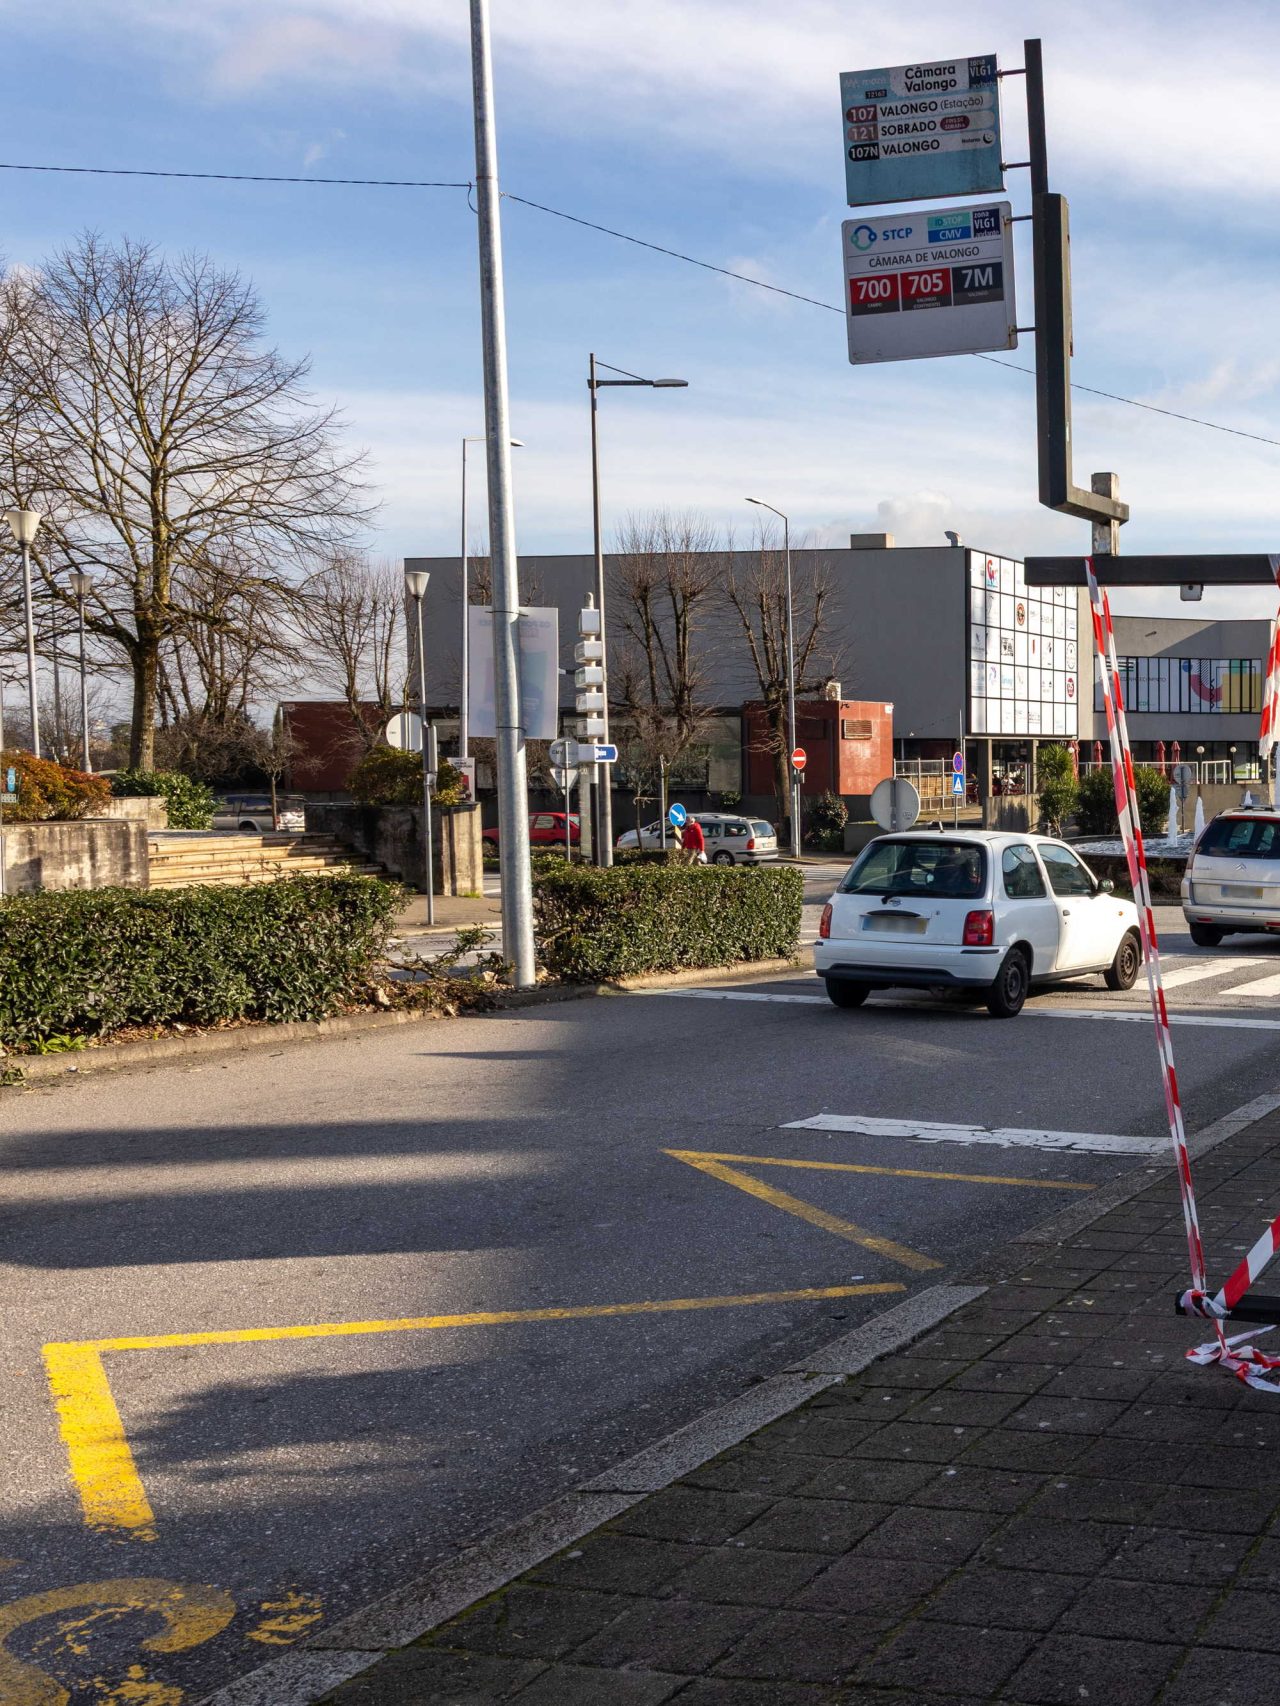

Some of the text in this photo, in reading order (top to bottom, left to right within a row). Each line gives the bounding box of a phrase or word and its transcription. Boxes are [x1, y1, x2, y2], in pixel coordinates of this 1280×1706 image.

[905, 65, 956, 80] Câmara
[970, 65, 991, 77] VLG1
[905, 79, 957, 93] Valongo
[850, 96, 984, 121] 107 VALONGO (Estação)
[852, 120, 937, 140] 121 SOBRADO
[851, 139, 940, 158] 107N VALONGO
[974, 218, 995, 229] VLG1
[882, 227, 913, 241] STCP
[939, 228, 962, 240] CMV
[869, 246, 980, 268] CÂMARA DE VALONGO
[908, 273, 944, 295] 705
[961, 267, 993, 289] 7M
[857, 278, 892, 300] 700
